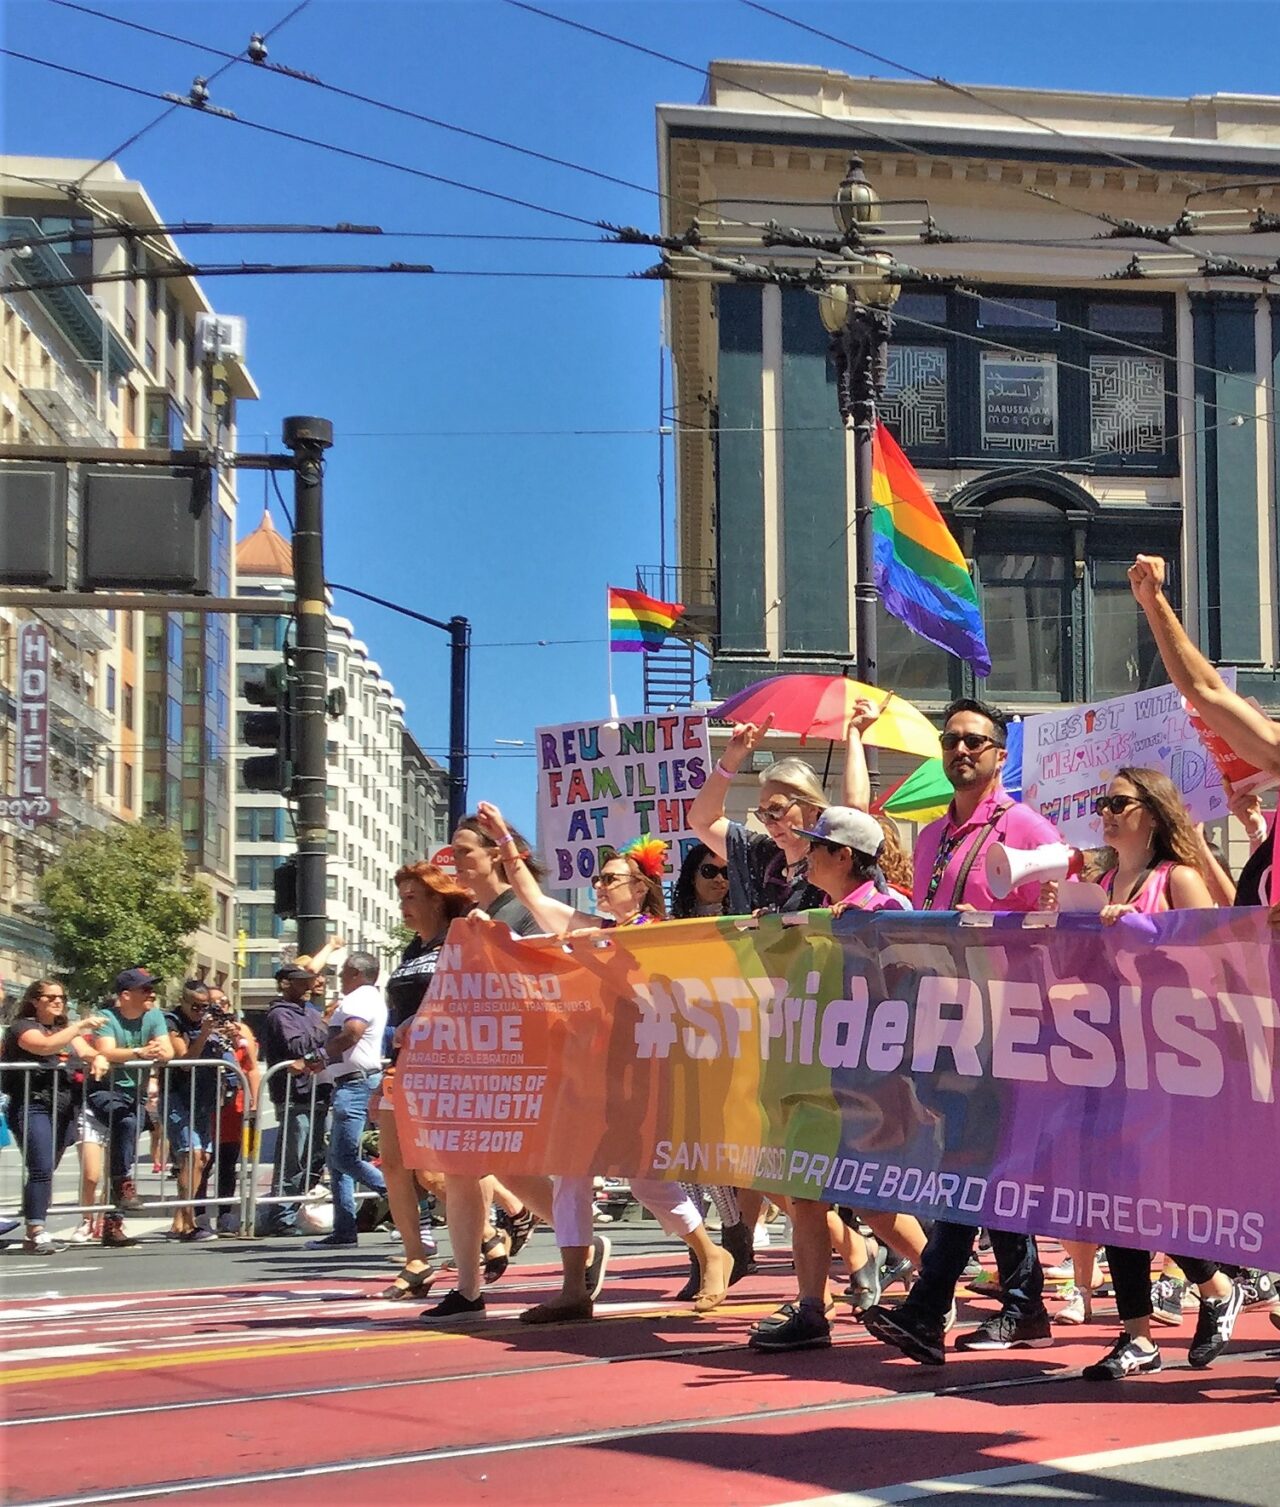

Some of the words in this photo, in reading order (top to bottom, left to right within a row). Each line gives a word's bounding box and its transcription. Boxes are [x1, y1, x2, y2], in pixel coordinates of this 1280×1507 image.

[987, 405, 1050, 415] DARUSSALAM
[23, 634, 46, 794] HOTEL
[548, 756, 707, 808] FAMILIES
[567, 806, 609, 842] AT
[409, 1015, 524, 1051] PRIDE
[406, 1053, 446, 1064] PARADE
[456, 1053, 525, 1065] CELEBRATION
[402, 1073, 522, 1092] GENERATIONS
[524, 1074, 547, 1092] OF
[405, 1092, 543, 1120] STRENGTH
[477, 1129, 524, 1153] 2018
[652, 1140, 709, 1172] SAN
[715, 1143, 788, 1181] FRANCISCO
[787, 1150, 880, 1194] PRIDE
[878, 1163, 988, 1213] BOARD
[993, 1180, 1045, 1219] OF
[1050, 1187, 1265, 1253] DIRECTORS
